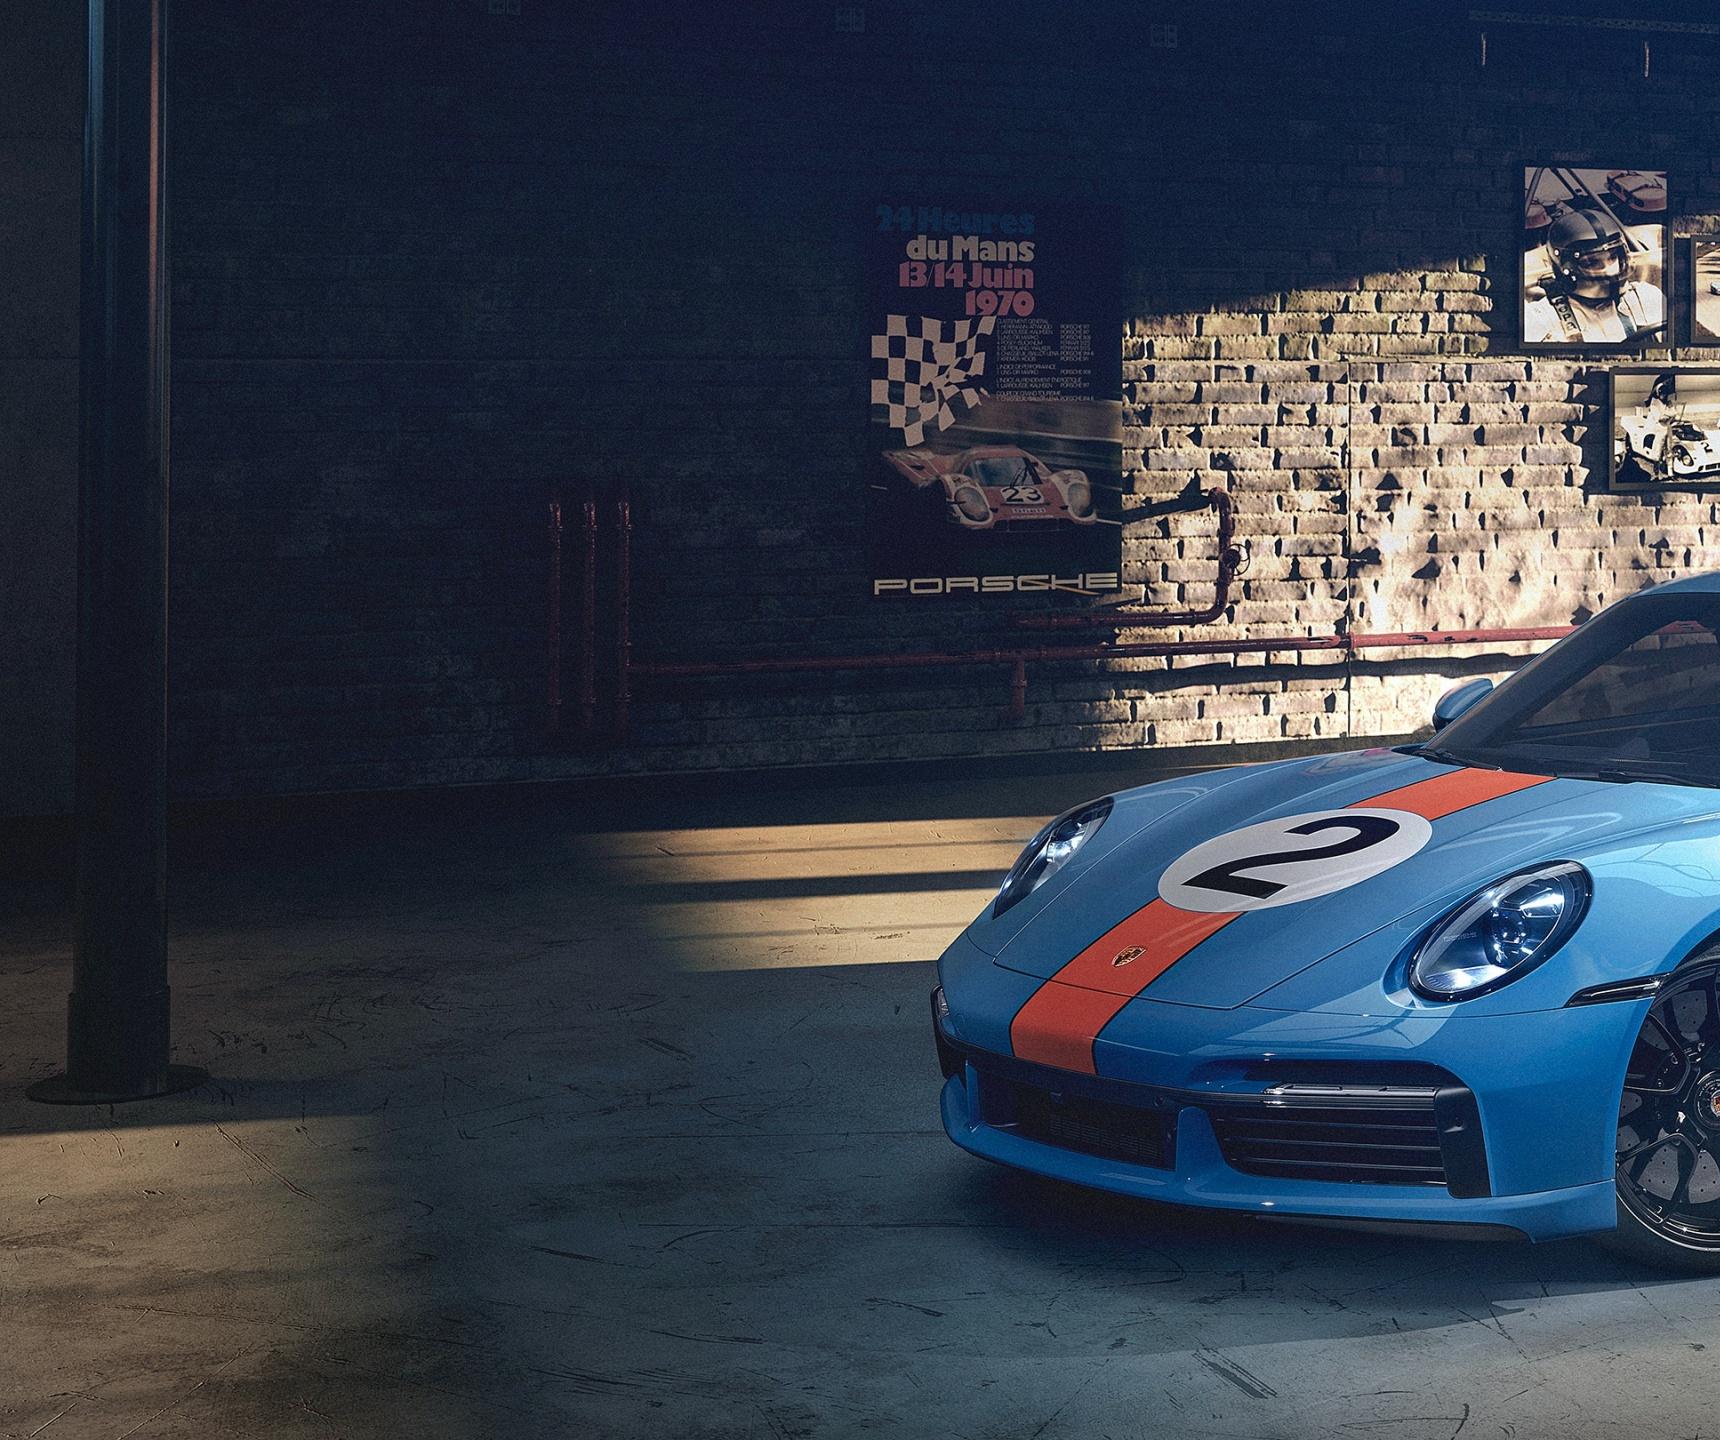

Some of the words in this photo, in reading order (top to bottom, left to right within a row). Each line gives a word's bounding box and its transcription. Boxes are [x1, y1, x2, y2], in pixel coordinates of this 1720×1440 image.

[917, 206, 1035, 235] Heures
[906, 235, 947, 261] du
[952, 236, 1036, 262] Mans
[899, 261, 967, 288] 13/14
[968, 263, 1034, 289] Juin
[965, 290, 1035, 317] 1970
[1002, 487, 1042, 502] 23
[873, 572, 1118, 596] PORSCHE
[1180, 815, 1401, 900] 2
